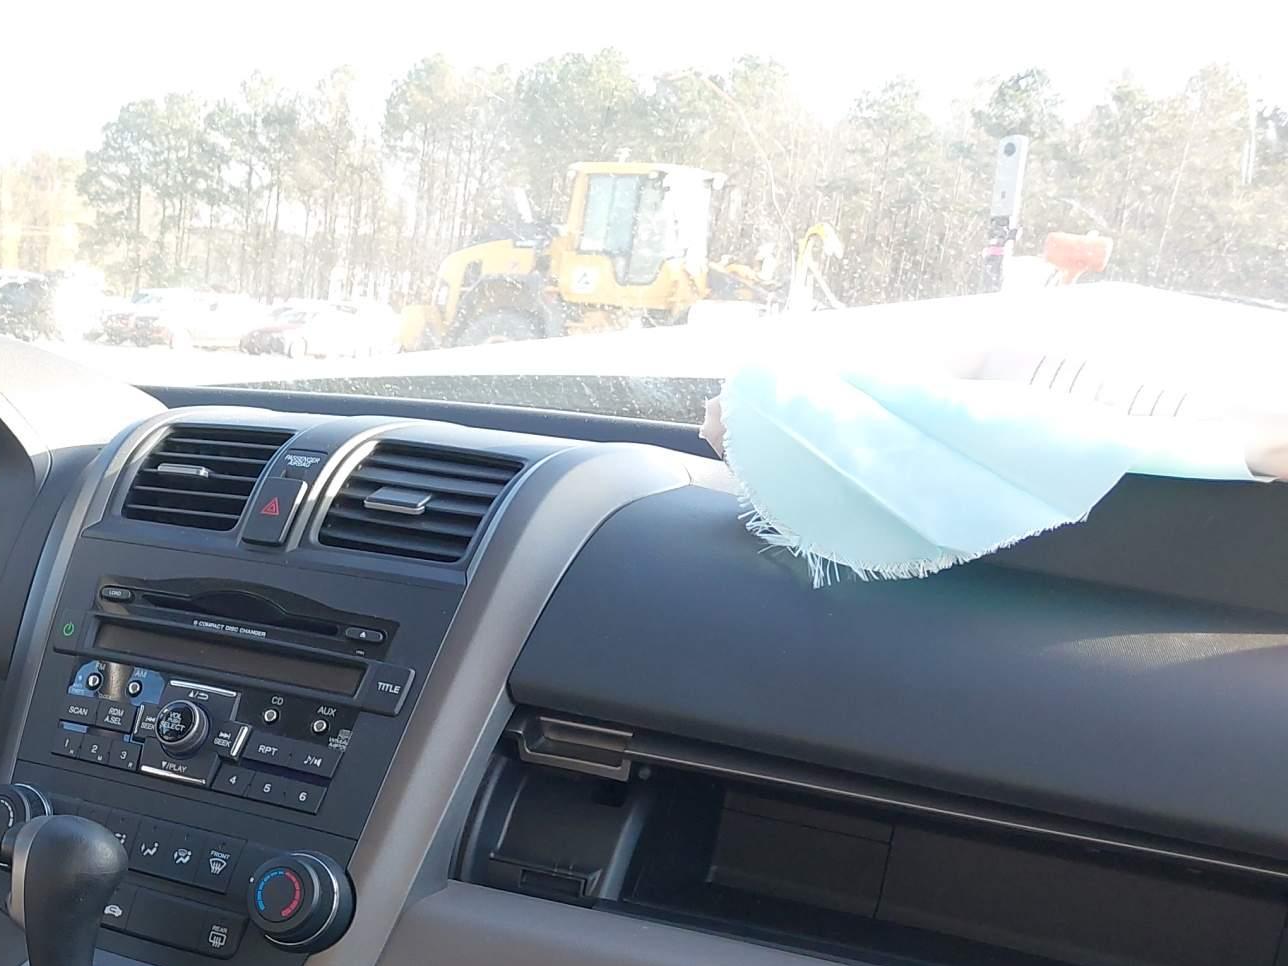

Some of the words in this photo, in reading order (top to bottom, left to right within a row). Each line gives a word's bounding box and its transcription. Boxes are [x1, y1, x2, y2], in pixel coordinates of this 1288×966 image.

[198, 620, 225, 630] COMPACT
[225, 625, 239, 633] DISC
[239, 627, 267, 637] CHANGER
[134, 670, 147, 678] AM
[377, 681, 401, 694] TITLE
[271, 696, 284, 705] CD
[68, 705, 89, 716] SCAN
[108, 707, 124, 717] RDM
[317, 706, 337, 717] AUX
[213, 738, 232, 748] SEEK
[91, 744, 98, 754] 2
[258, 744, 278, 756] RPT
[120, 751, 127, 760] 3
[229, 776, 237, 784] 4
[263, 783, 271, 793] 5
[298, 792, 307, 801] 6
[210, 849, 231, 860] FRONT
[212, 924, 228, 933] REAR
